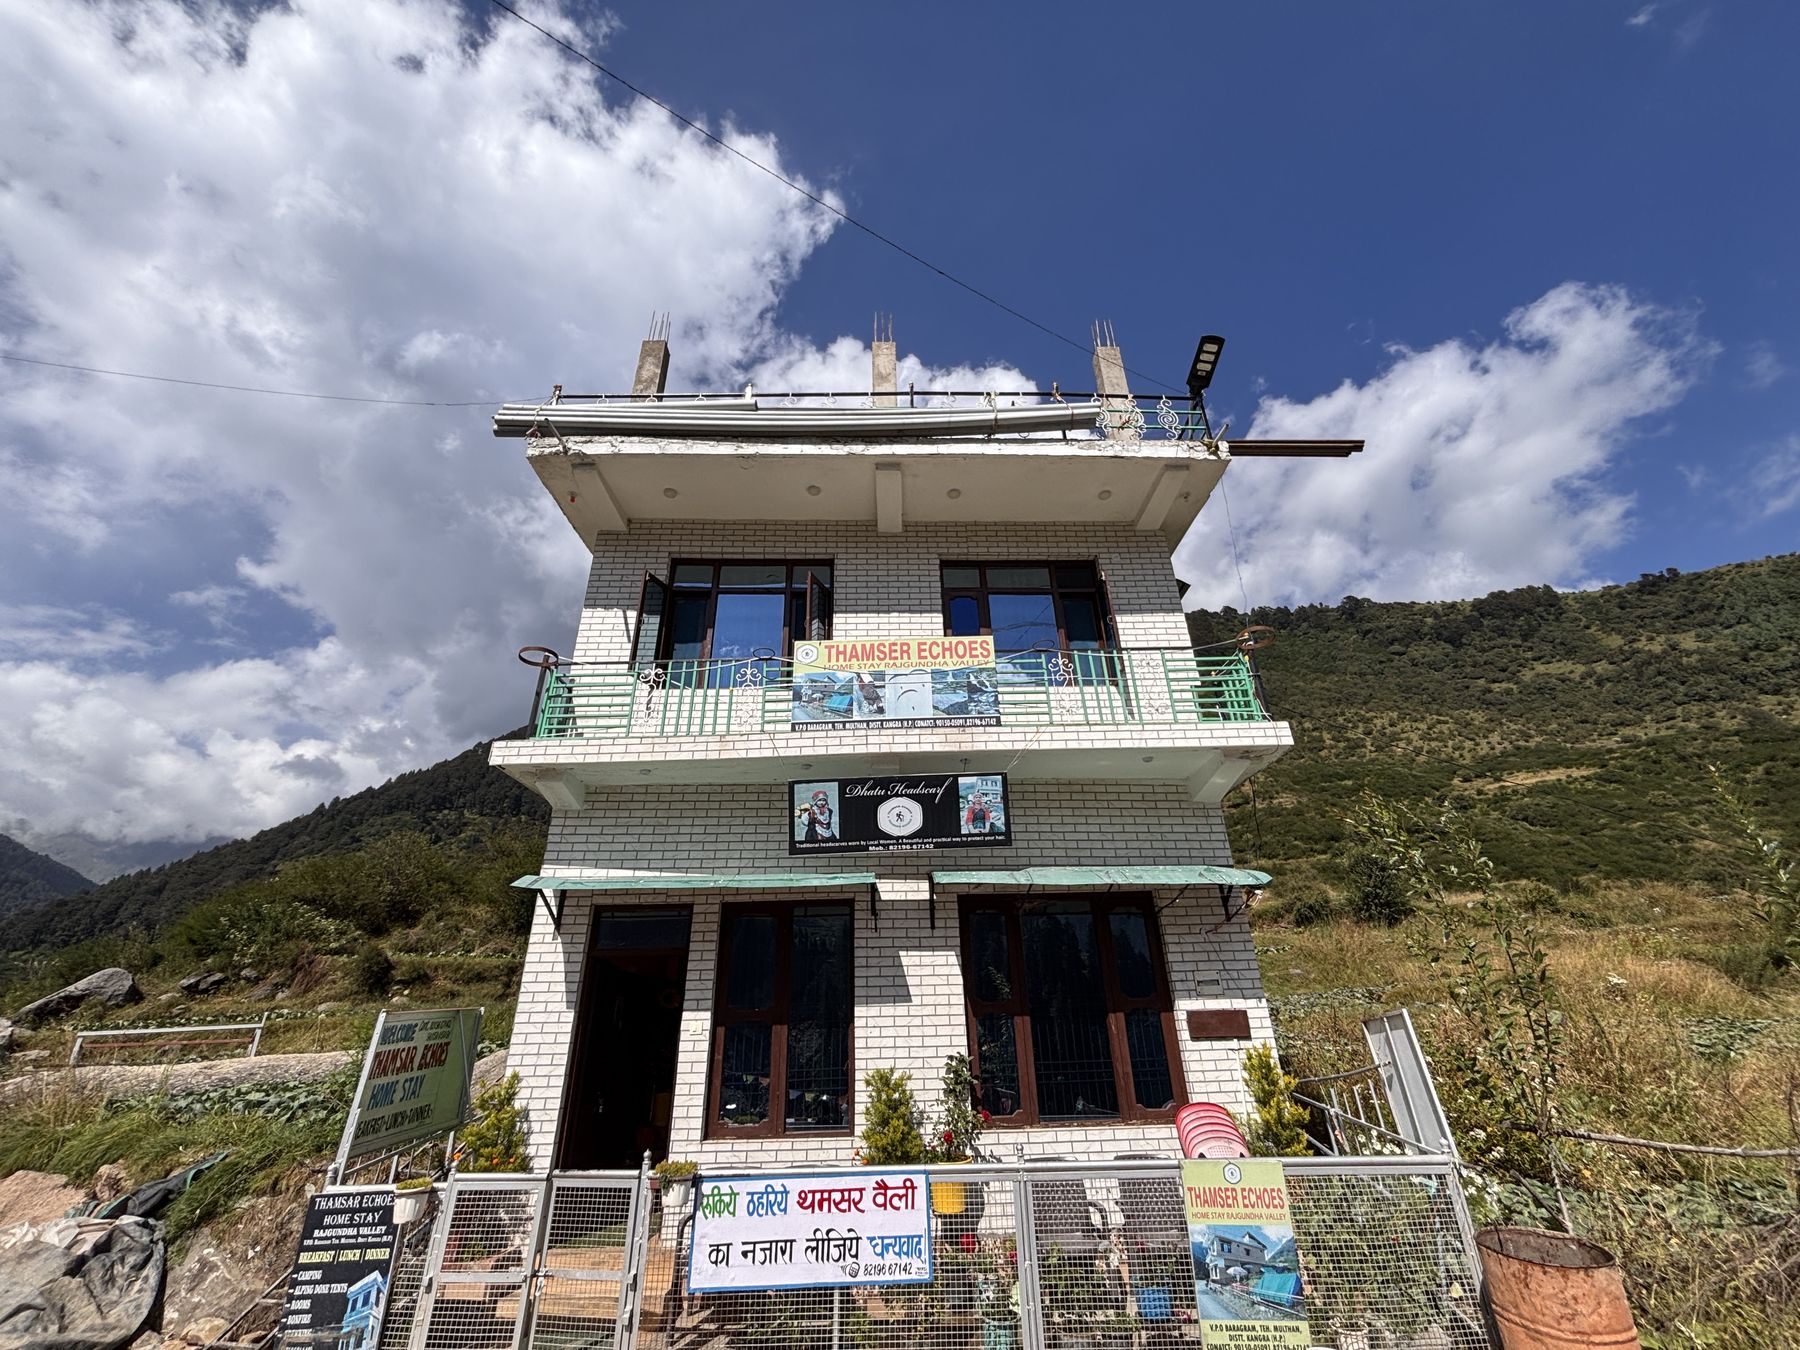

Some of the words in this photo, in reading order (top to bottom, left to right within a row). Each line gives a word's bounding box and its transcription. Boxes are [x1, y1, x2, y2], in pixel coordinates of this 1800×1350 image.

[825, 642, 911, 663] THAMSER
[917, 640, 991, 660] ECHOES
[824, 663, 855, 671] HOME
[857, 662, 882, 670] STAY
[884, 661, 949, 669] RAJGUNDHA
[952, 659, 990, 668] VALLEY
[845, 780, 885, 797] Dhatu
[888, 777, 953, 804] Headscarf
[889, 843, 934, 851] 82196-67142
[380, 1023, 419, 1046] WELCOME
[366, 1080, 399, 1111] HOME
[400, 1074, 426, 1102] STAY
[314, 1195, 361, 1210] THAMSAR
[797, 1186, 866, 1214] थमसर
[872, 1178, 917, 1211] वैली
[1187, 1186, 1240, 1209] THAMSER
[1241, 1187, 1285, 1210] ECHOES
[323, 1213, 352, 1226] HOME
[353, 1210, 383, 1224] STAY
[1191, 1212, 1210, 1220] HOME
[1210, 1212, 1226, 1220] STAY
[1226, 1212, 1264, 1220] RAJGUNDHA
[1265, 1213, 1286, 1221] VALLEY
[313, 1227, 358, 1238] RAJGUNDHA
[359, 1225, 388, 1235] VALLEY
[298, 1250, 335, 1263] BREAKFAST
[339, 1249, 362, 1262] LUNCH
[365, 1248, 390, 1260] DINNER
[708, 1242, 733, 1267] का
[741, 1238, 797, 1265] नजारा
[298, 1270, 323, 1280] CAMPING
[290, 1299, 312, 1310] ROOMS
[1225, 1324, 1258, 1333] BARAGRAM,
[1259, 1325, 1272, 1333] TEH.
[1246, 1334, 1270, 1342] KANGRA
